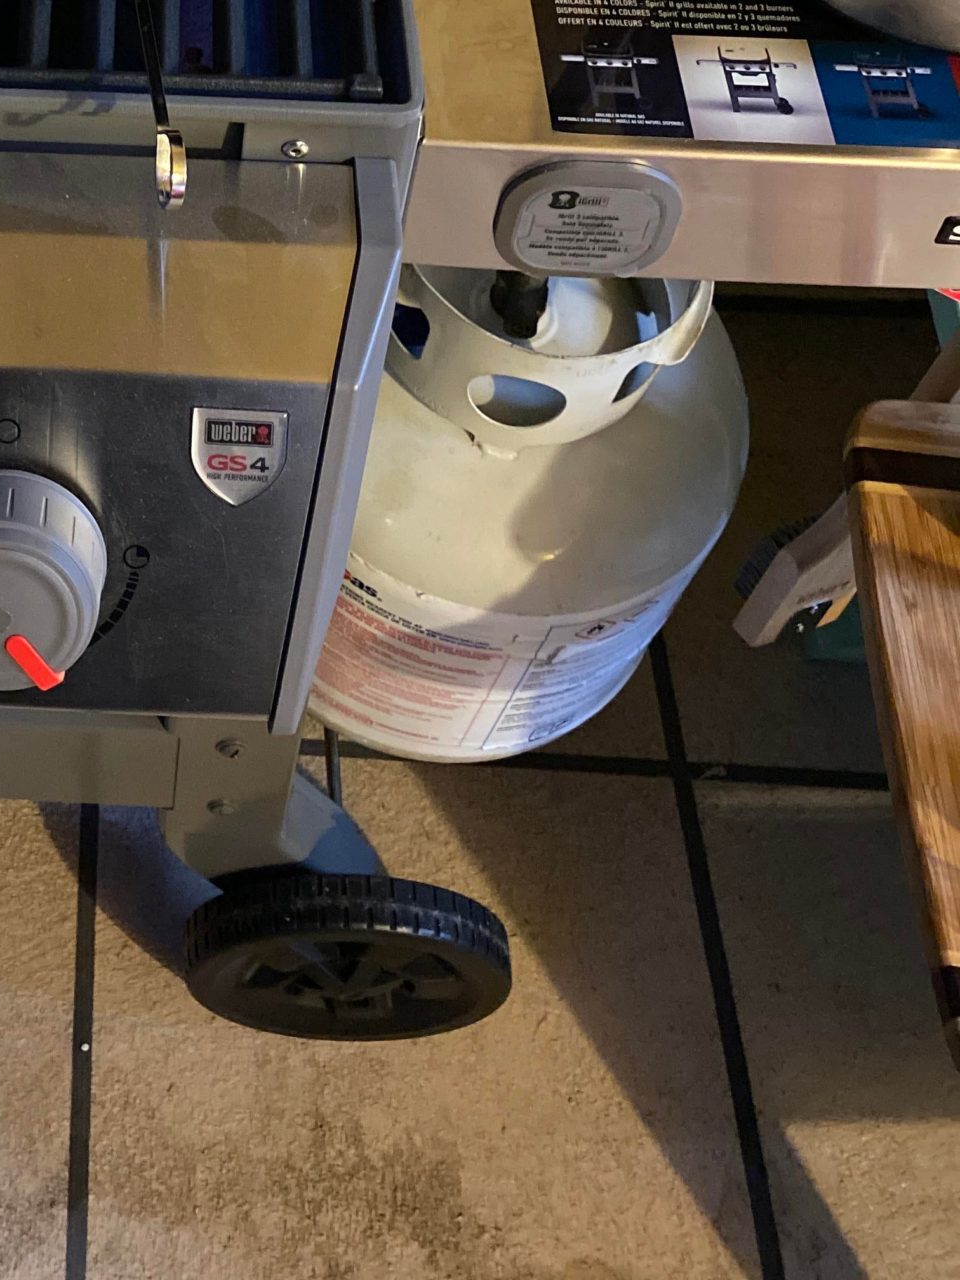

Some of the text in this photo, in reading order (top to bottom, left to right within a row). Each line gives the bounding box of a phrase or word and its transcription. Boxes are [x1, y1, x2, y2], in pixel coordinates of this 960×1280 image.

[610, 0, 638, 7] COLORS
[556, 7, 599, 15] DISPONIBLE
[558, 17, 585, 25] OFFERT
[605, 19, 643, 27] COULEURS
[211, 421, 256, 442] weber
[224, 473, 269, 482] PERFORMANCE
